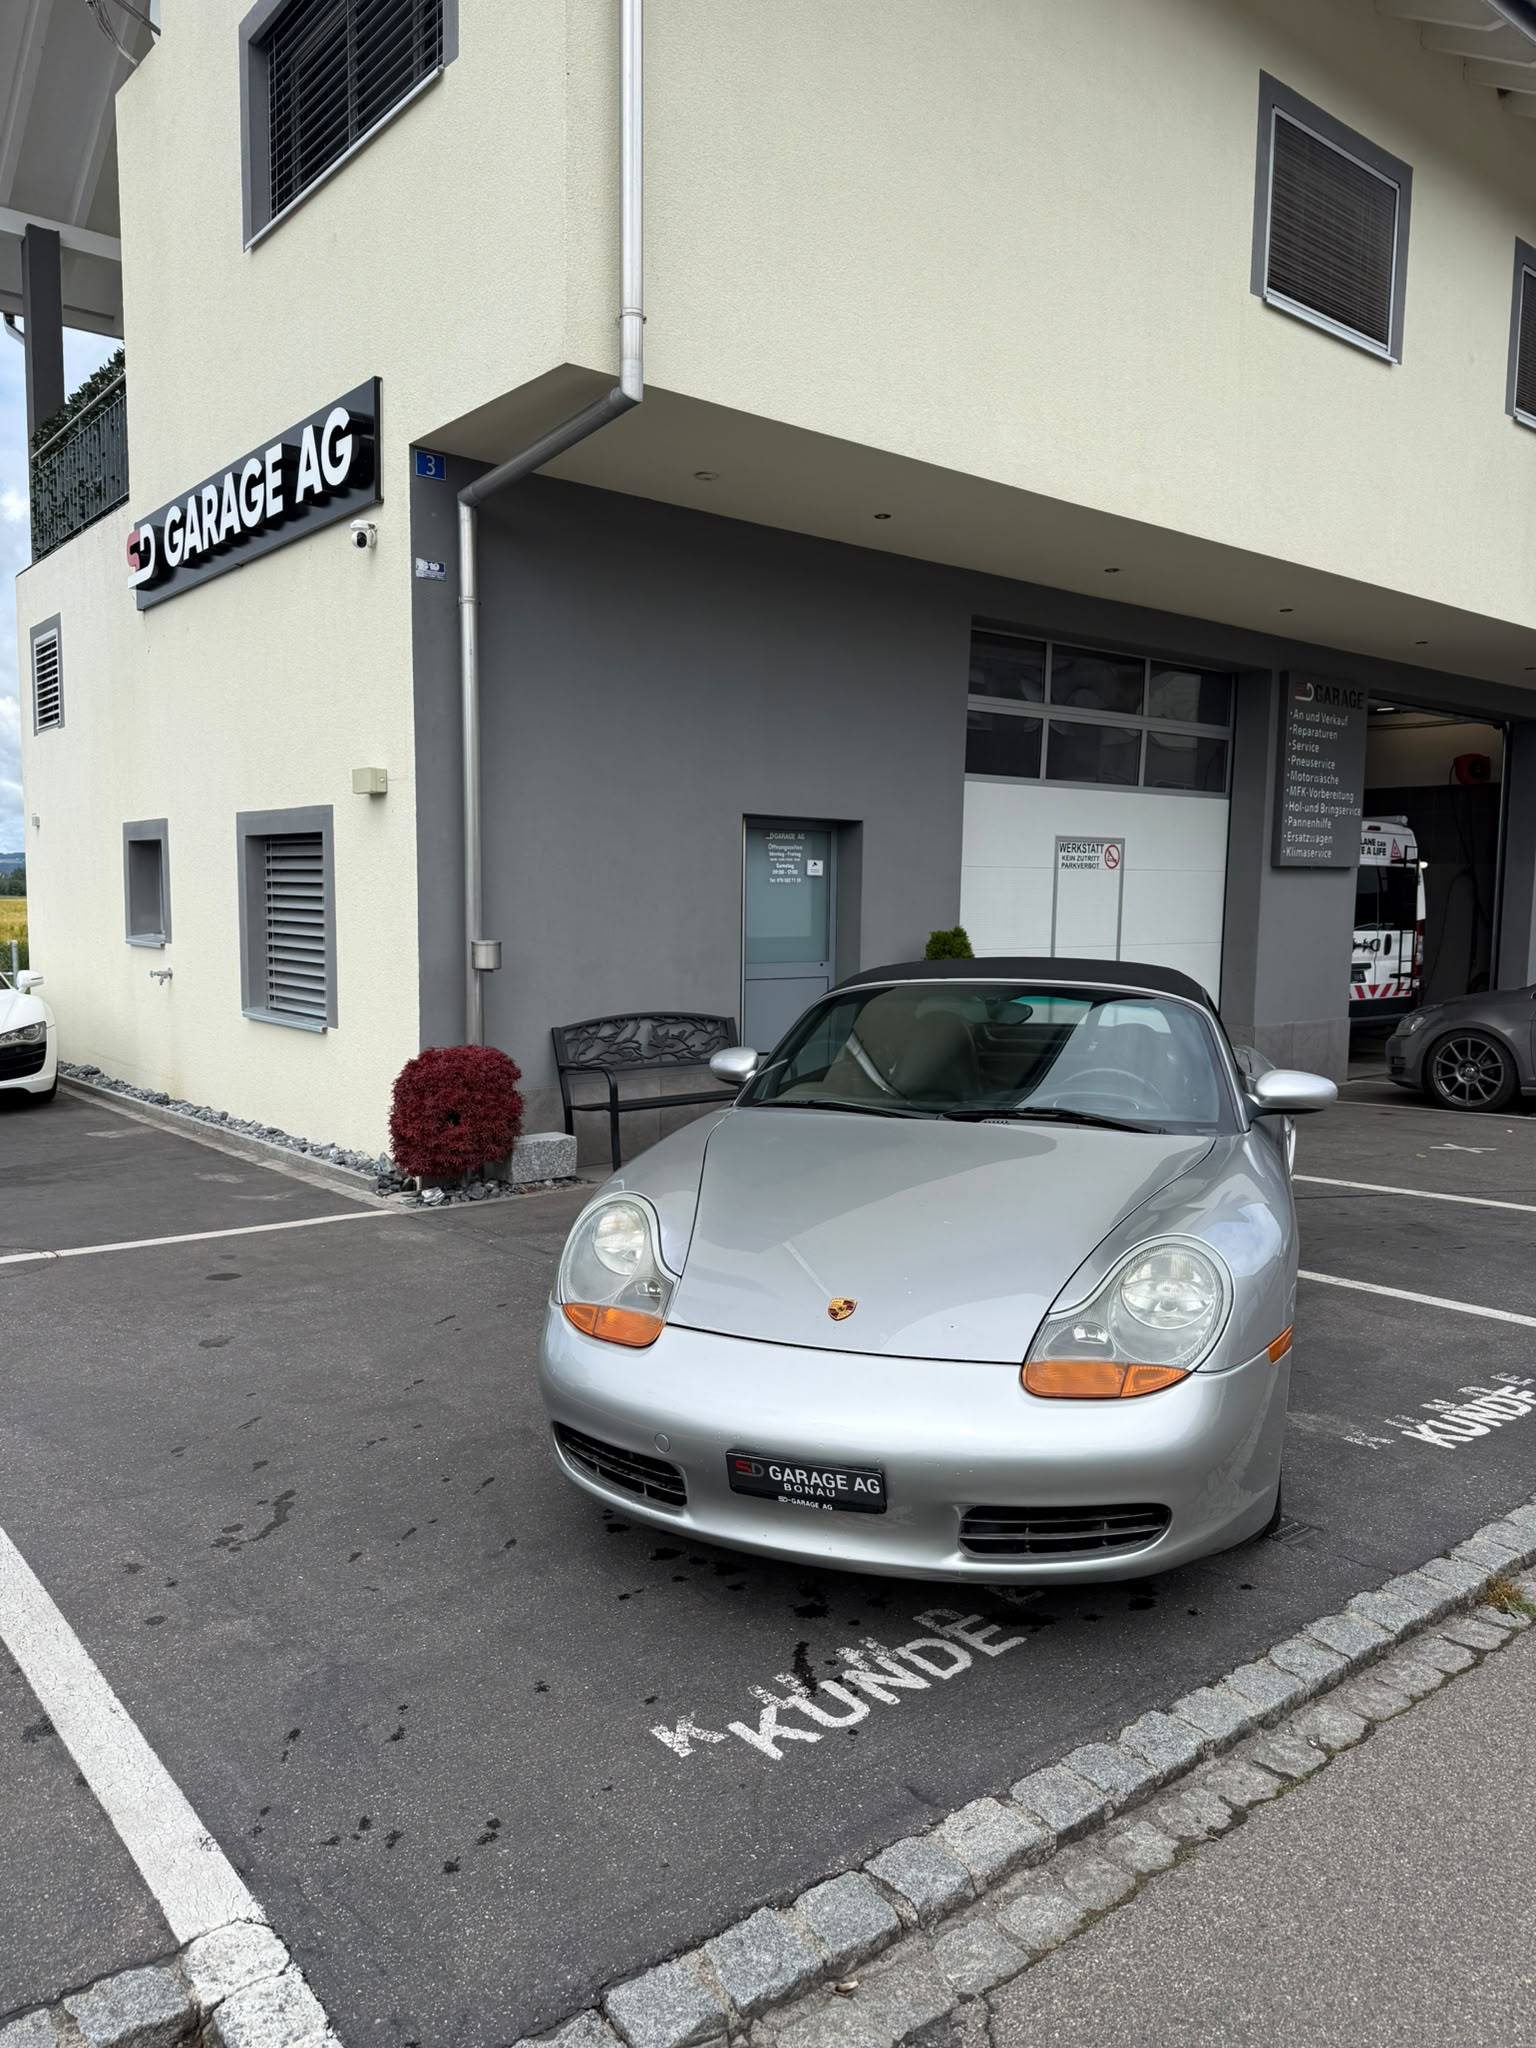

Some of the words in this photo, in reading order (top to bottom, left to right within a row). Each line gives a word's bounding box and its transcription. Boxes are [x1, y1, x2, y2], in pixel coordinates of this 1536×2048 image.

[426, 455, 436, 475] 3
[164, 442, 284, 567] GARAGE
[296, 407, 353, 504] AG
[1315, 685, 1364, 709] GARAGE
[1293, 709, 1304, 720] An
[1306, 712, 1320, 722] und
[1321, 713, 1348, 726] Verkauf
[1292, 724, 1337, 739] Reparaturen
[1292, 740, 1319, 752] Service
[1291, 755, 1335, 769] Pneuservice
[1289, 786, 1354, 803] MFK-Vorbereitung
[1320, 803, 1361, 817] Bringservice
[1288, 816, 1332, 829] Pannenhilfe
[1287, 831, 1333, 846] Ersatzwagen
[1060, 843, 1104, 854] WERKSTATT
[1286, 847, 1332, 858] Klimaservice
[1373, 847, 1387, 856] LIFE
[1401, 1385, 1536, 1449] KUNDE
[769, 1465, 849, 1491] GARAGE
[853, 1477, 880, 1494] AG
[784, 1483, 836, 1497] BONAU
[822, 1503, 833, 1511] AG
[727, 1612, 1027, 1760] KUNDE
